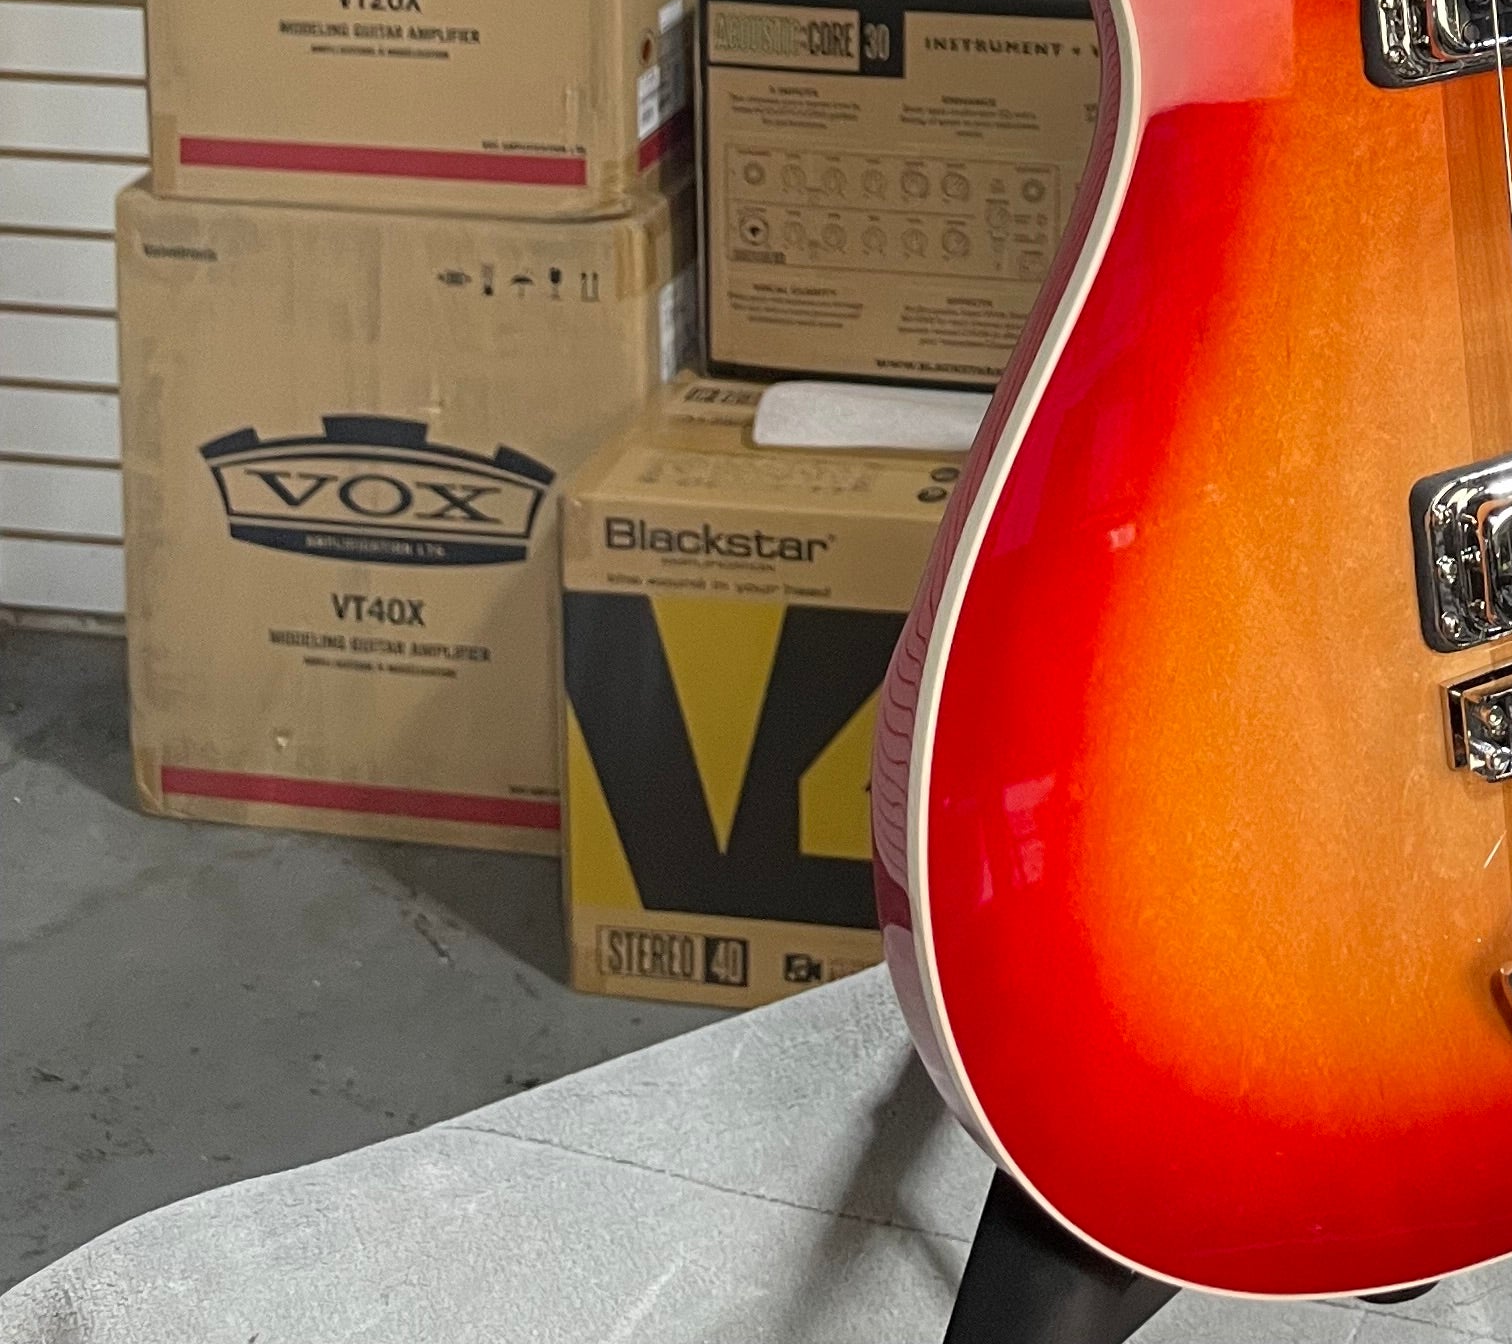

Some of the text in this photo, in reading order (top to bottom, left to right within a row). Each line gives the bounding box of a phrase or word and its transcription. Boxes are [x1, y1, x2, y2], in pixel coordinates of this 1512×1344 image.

[863, 22, 891, 62] 30
[924, 34, 1063, 58] INSTRUMENT
[243, 468, 503, 524] VOX
[605, 516, 829, 563] Blackstar
[331, 592, 426, 628] VT40X
[607, 928, 743, 983] STEREO 40
